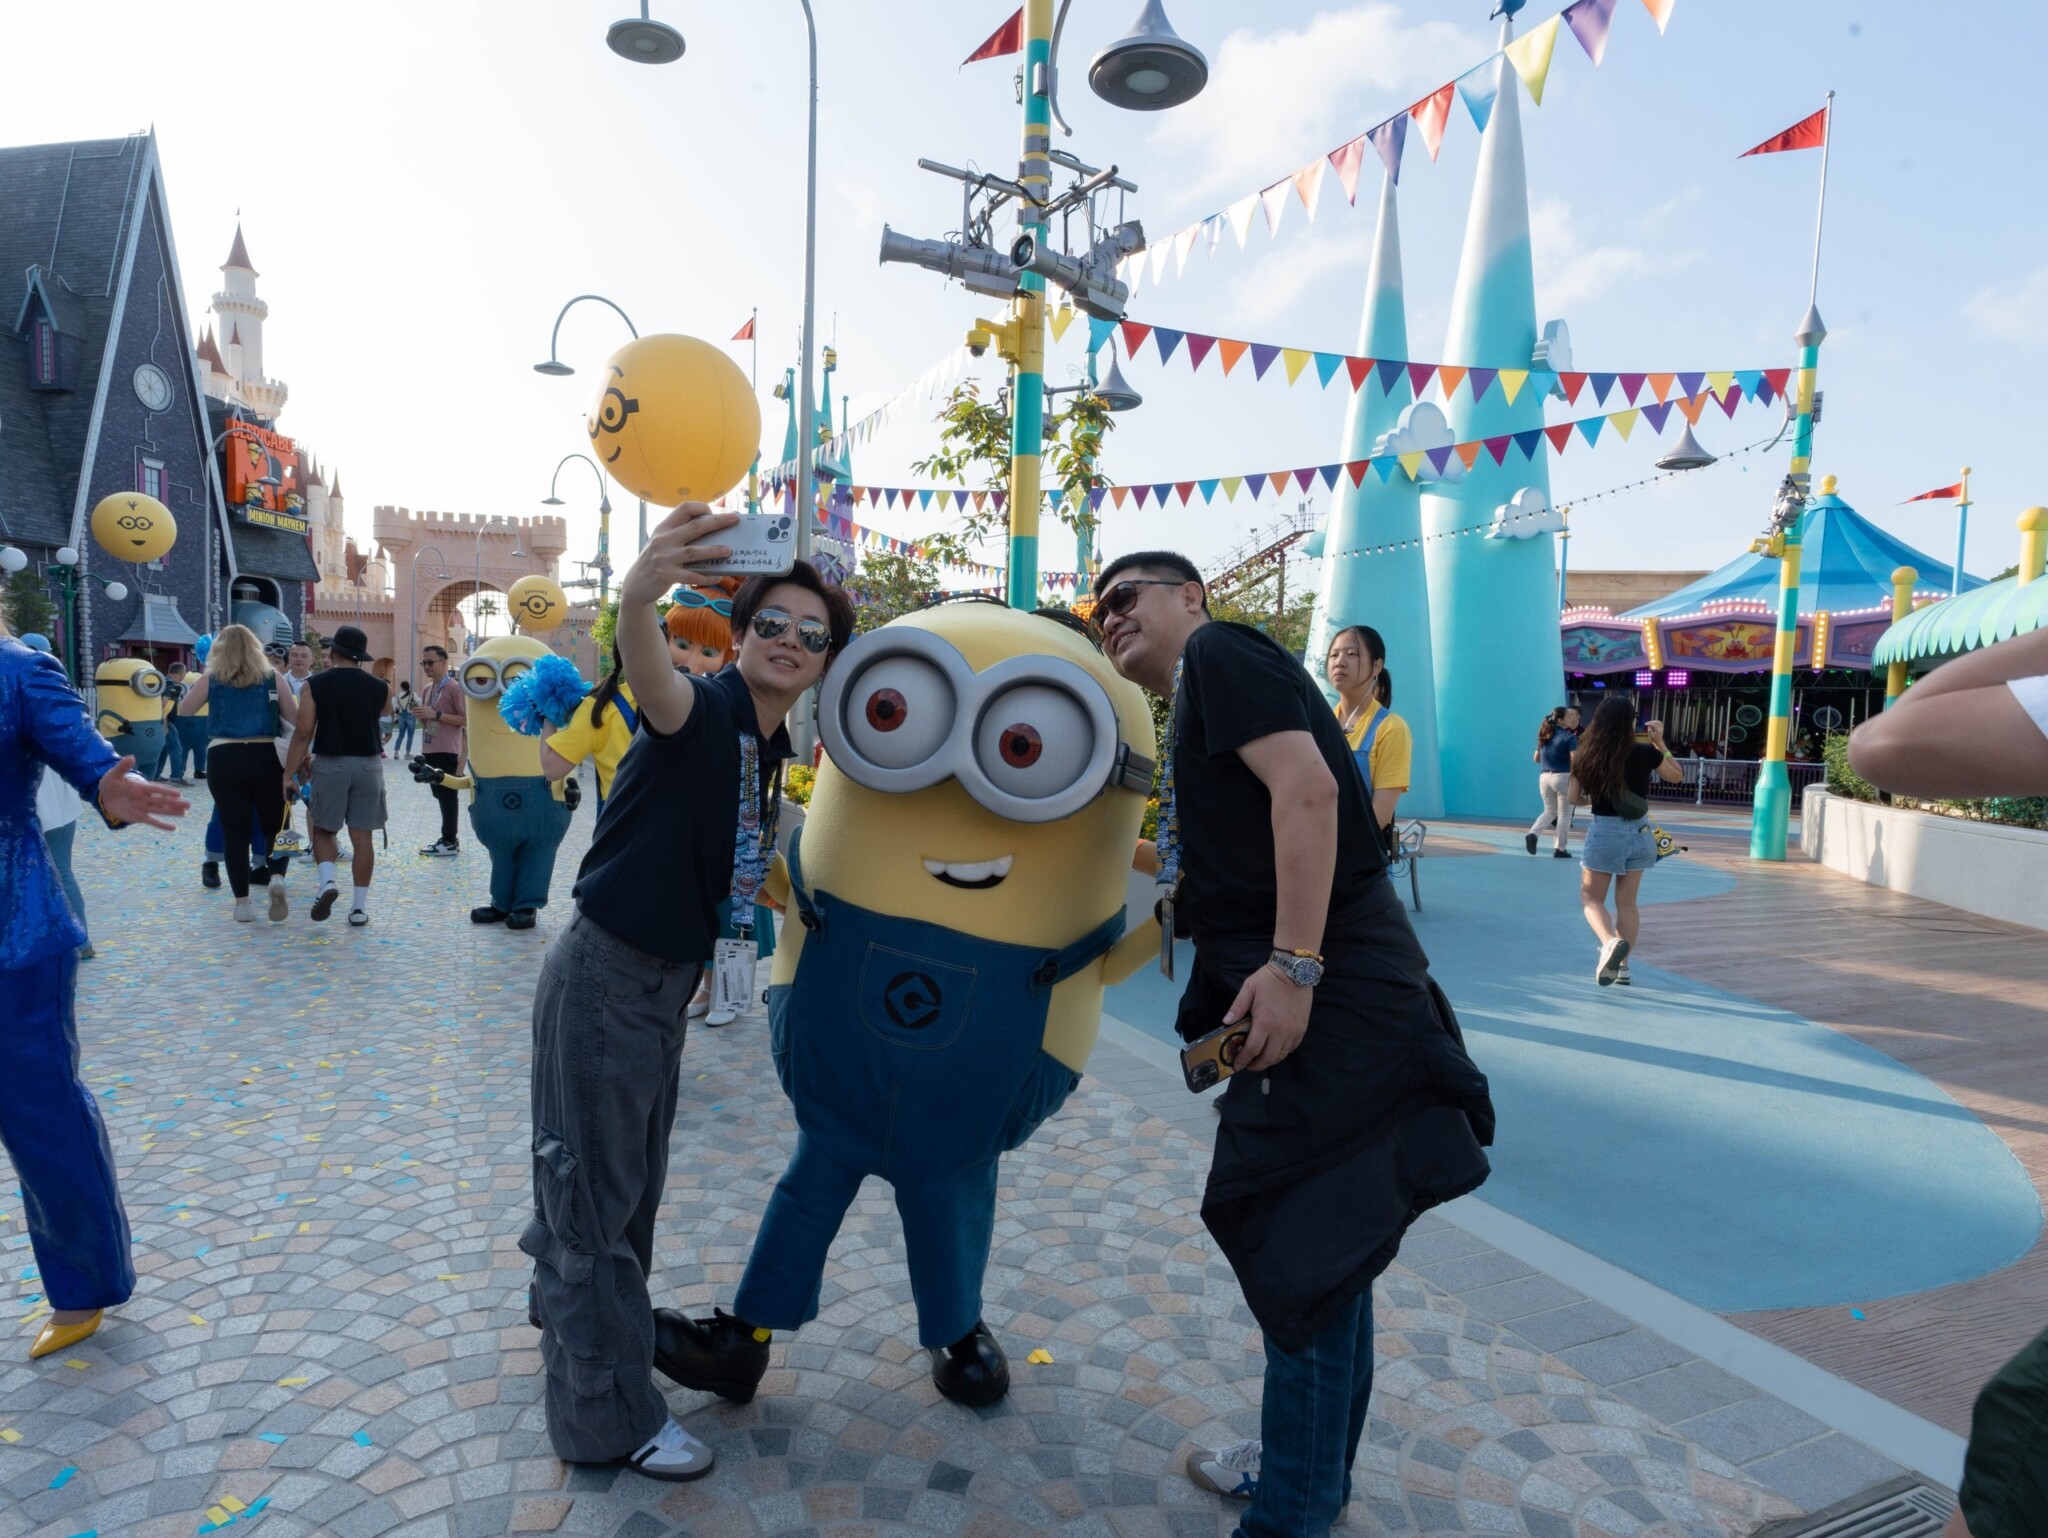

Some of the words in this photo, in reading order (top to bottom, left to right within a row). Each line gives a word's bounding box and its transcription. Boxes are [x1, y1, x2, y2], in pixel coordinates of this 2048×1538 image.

[232, 420, 297, 453] DESPICABLE
[249, 510, 275, 525] MINION
[277, 515, 306, 532] MAYHEM
